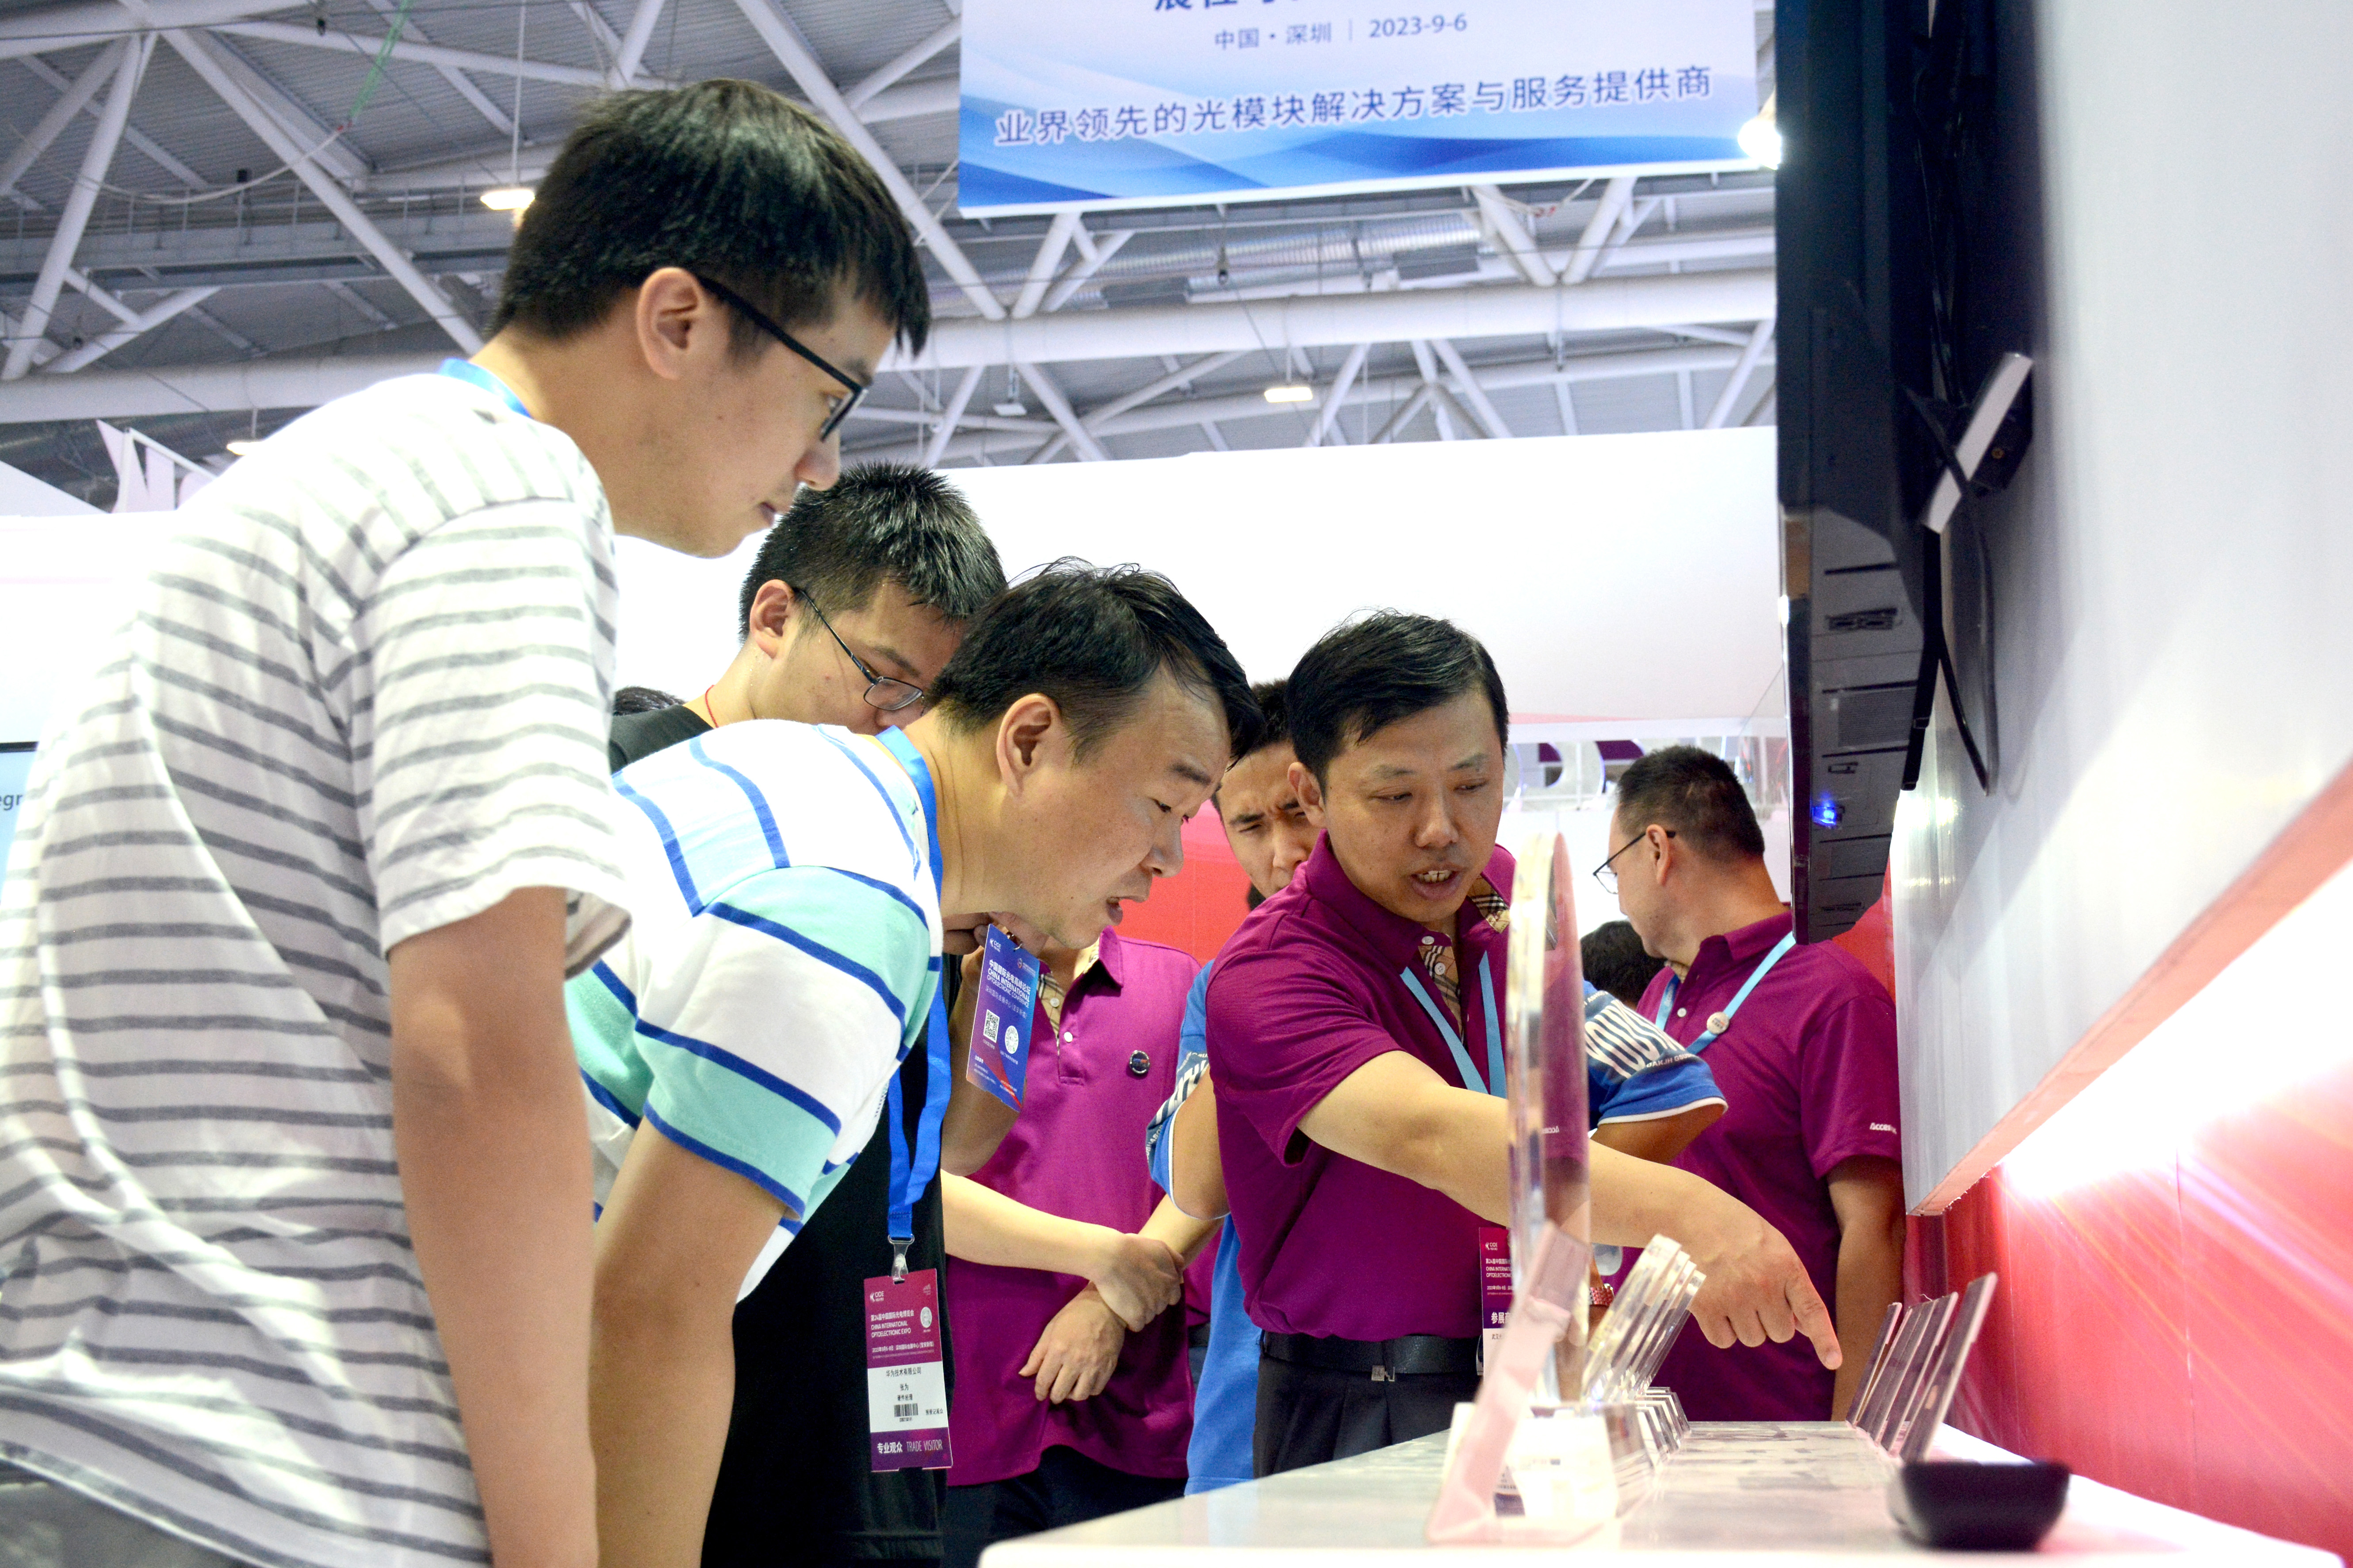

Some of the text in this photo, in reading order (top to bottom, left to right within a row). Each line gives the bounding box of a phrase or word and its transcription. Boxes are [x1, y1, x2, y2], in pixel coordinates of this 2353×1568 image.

[1370, 13, 1468, 38] 2023-9-6
[998, 66, 1711, 144] 业界领先的光模块解决方案与服务提供商
[988, 968, 1000, 982] CHINA
[1001, 977, 1030, 1002] INTERNATIONAL
[871, 1329, 901, 1338] OPTOELECTRONIC
[886, 1367, 922, 1377] 华为技术有限公司
[877, 1439, 943, 1454] 专业观众 TRADE VISITOR
